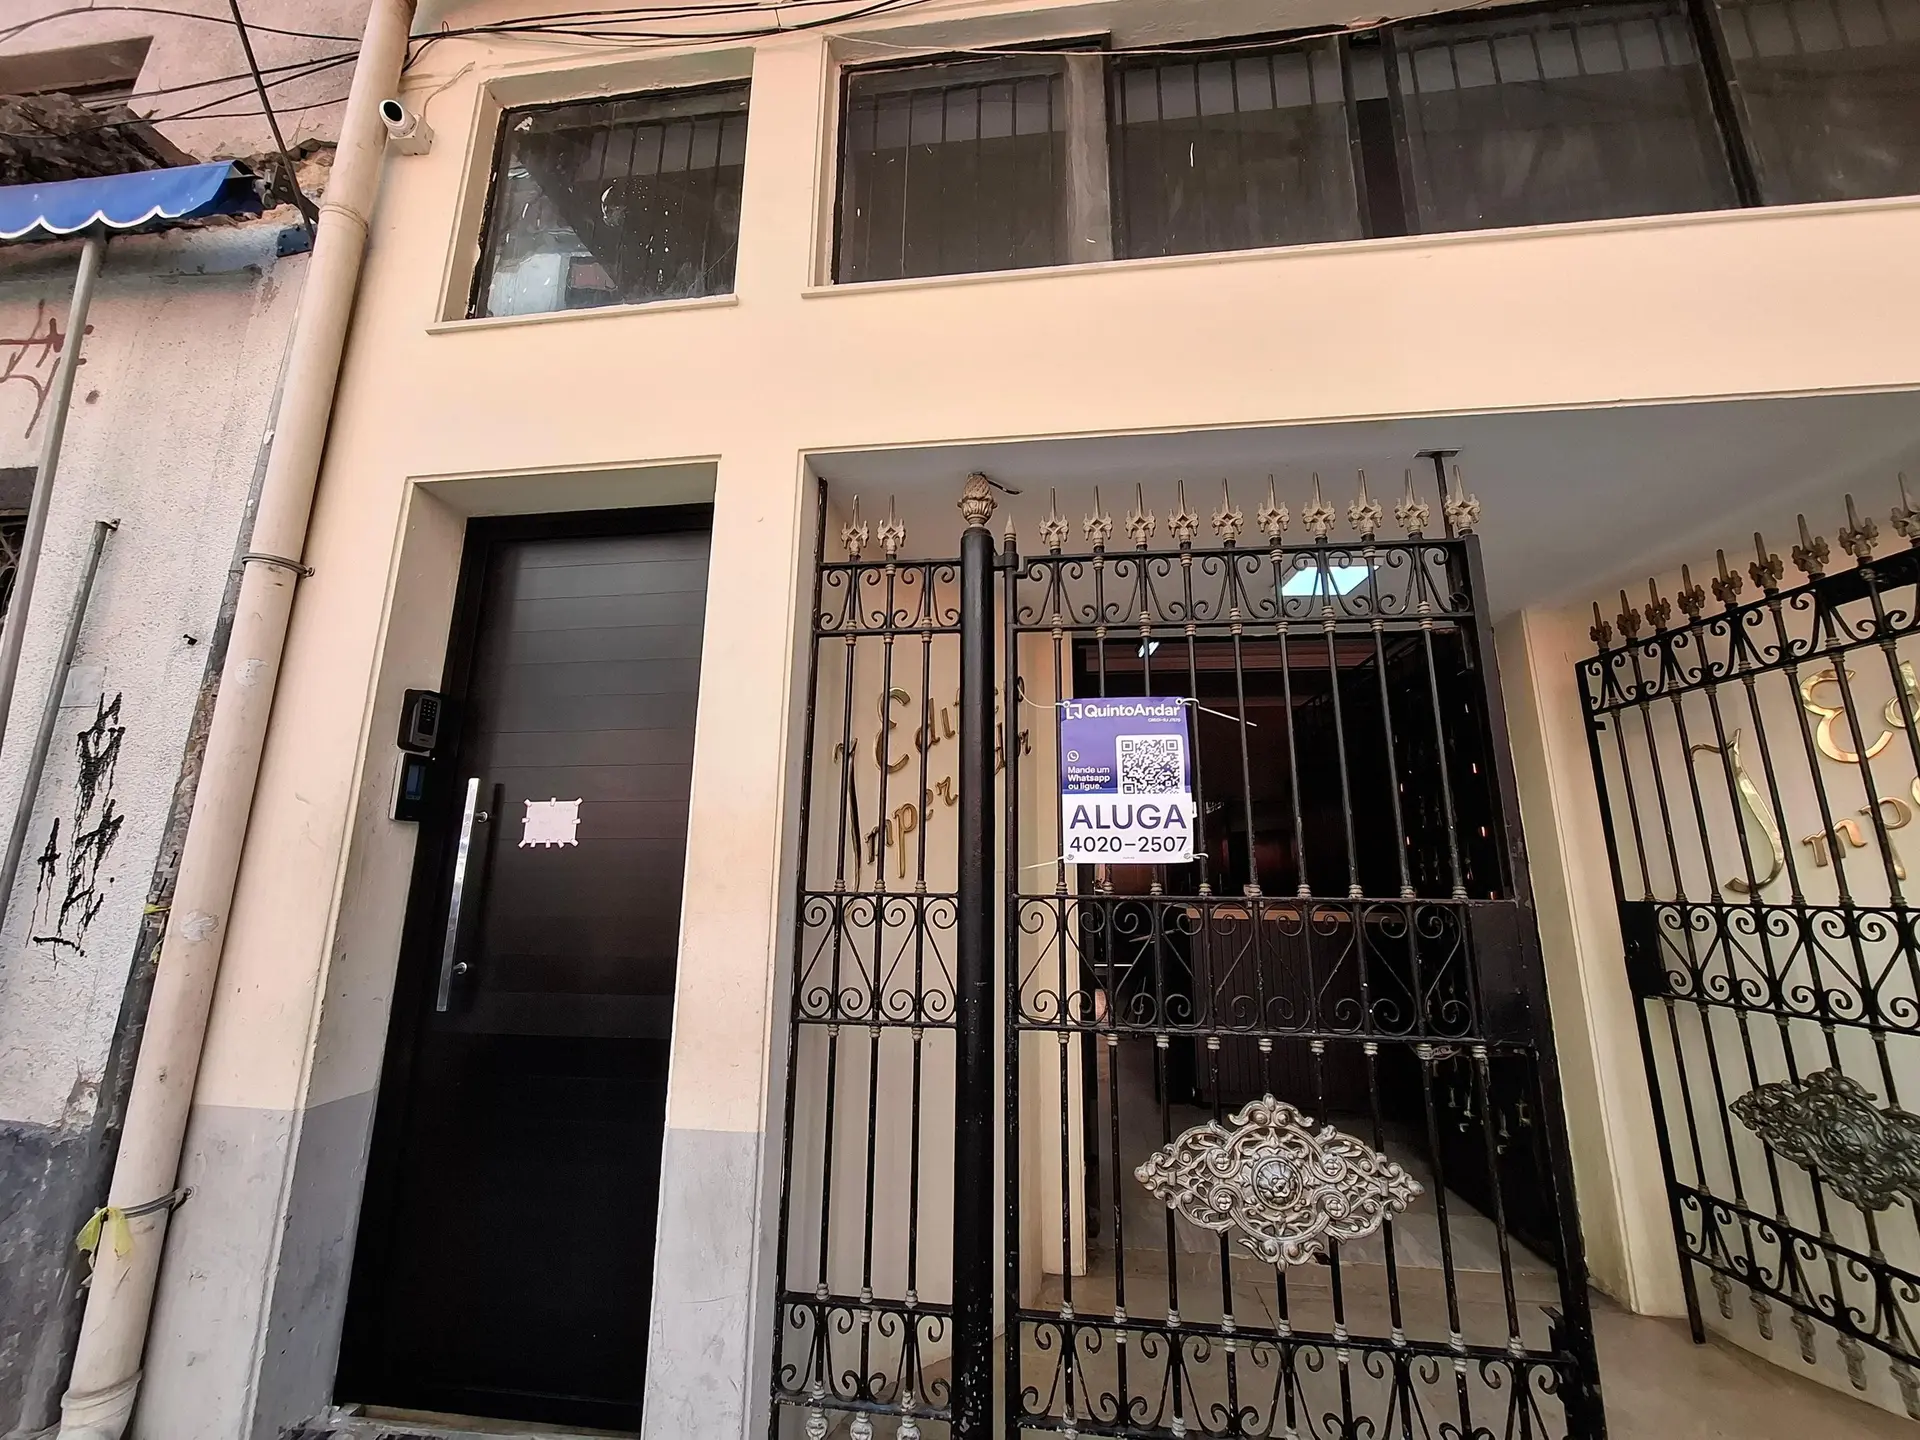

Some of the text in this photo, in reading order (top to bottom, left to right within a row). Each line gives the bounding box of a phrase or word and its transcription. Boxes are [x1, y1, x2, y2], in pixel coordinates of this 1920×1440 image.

[1084, 704, 1181, 718] QuintoAndar
[1067, 766, 1096, 774] Mande
[1067, 774, 1111, 783] Whatsapp
[1080, 782, 1103, 791] ligue.
[1070, 804, 1187, 829] ALUGA
[1070, 836, 1188, 852] 4020-2507
